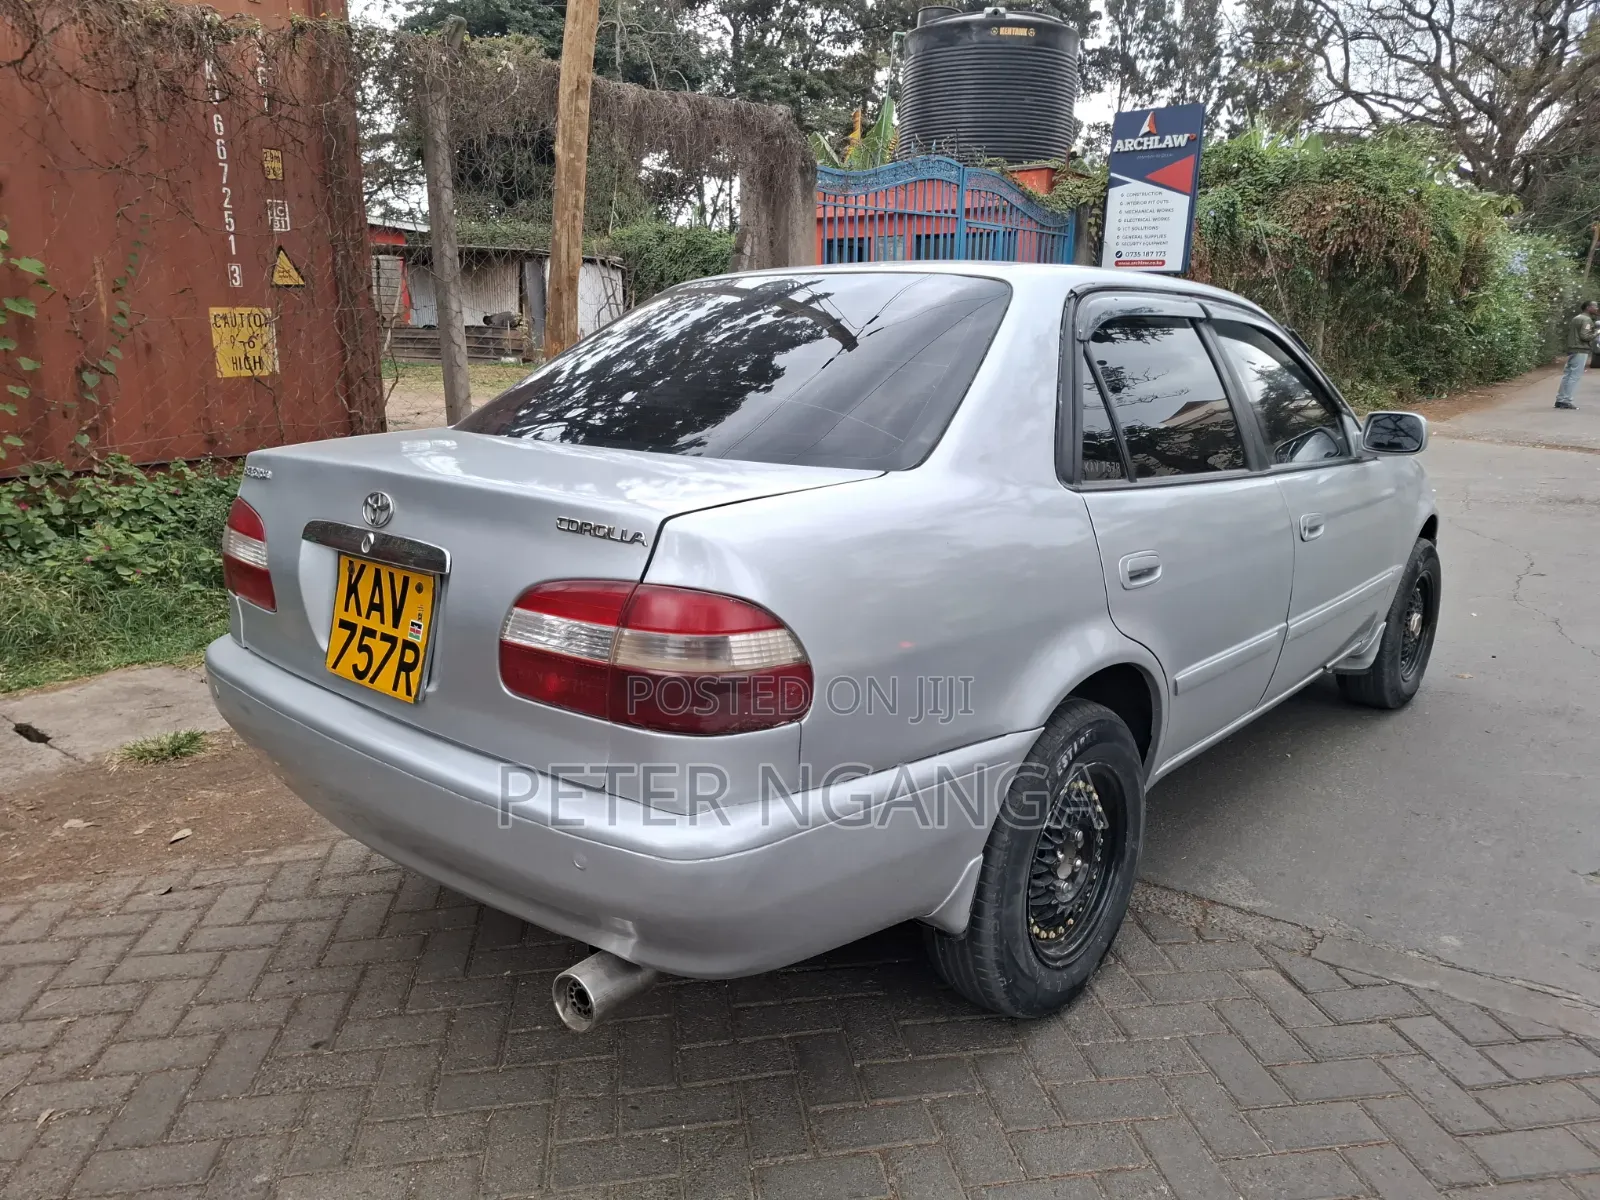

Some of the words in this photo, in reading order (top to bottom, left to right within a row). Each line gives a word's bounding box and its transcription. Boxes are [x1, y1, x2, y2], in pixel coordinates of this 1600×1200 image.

[1113, 134, 1190, 152] ARCHLAW
[231, 355, 263, 372] HIGH
[556, 516, 648, 547] COROLLA
[343, 560, 410, 630] KAV
[331, 618, 421, 698] 757R
